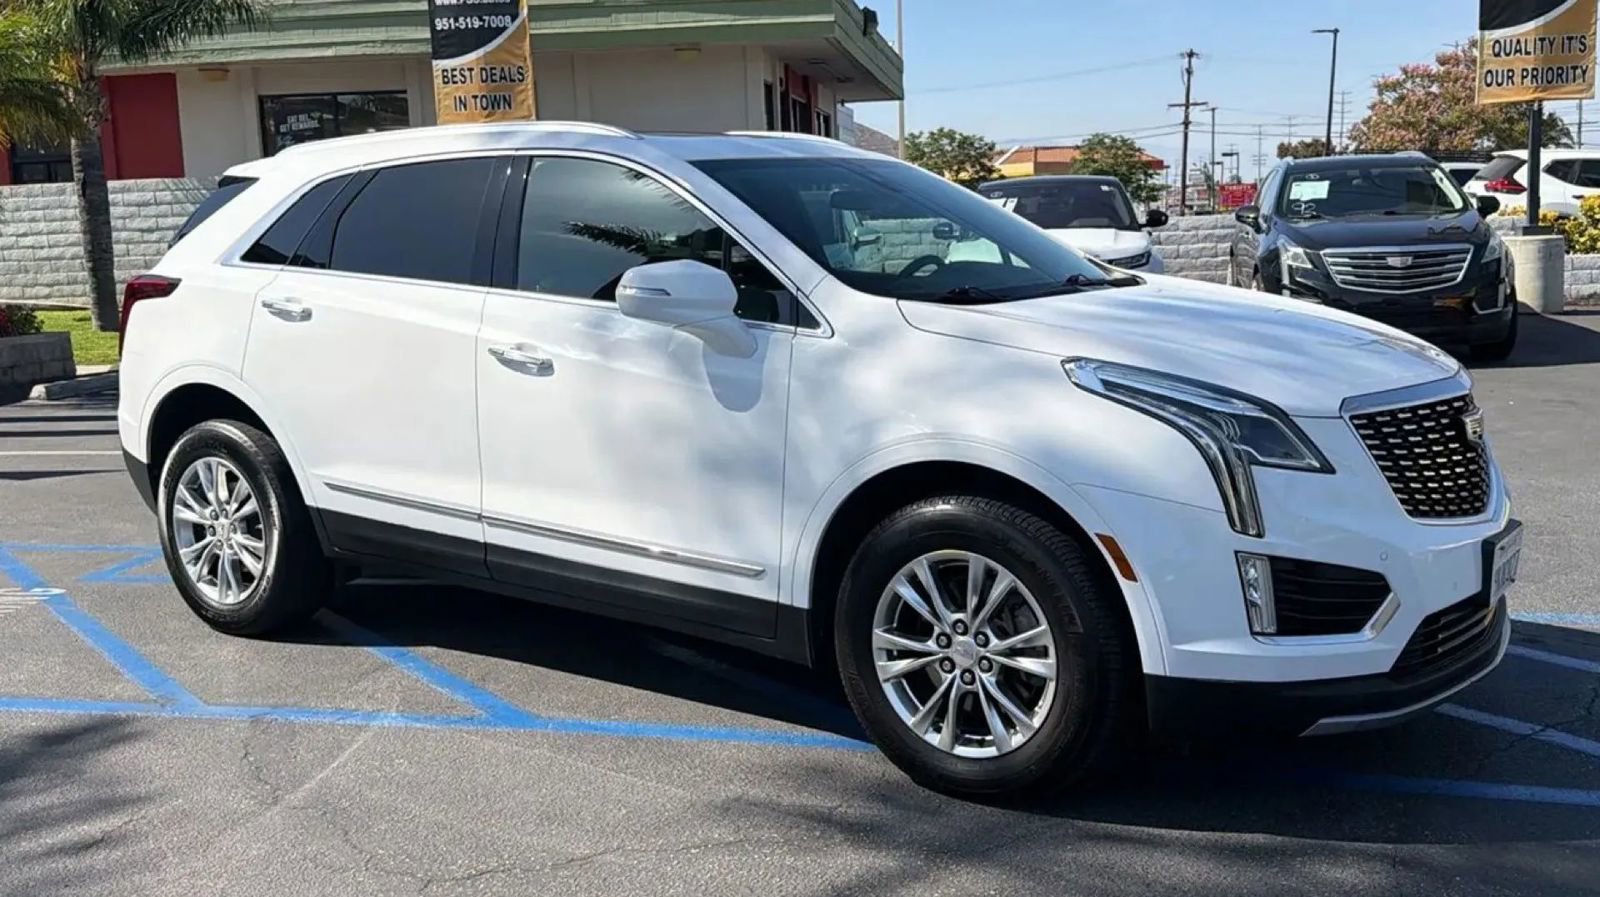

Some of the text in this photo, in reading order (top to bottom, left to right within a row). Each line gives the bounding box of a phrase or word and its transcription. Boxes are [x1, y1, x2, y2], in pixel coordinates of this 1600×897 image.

[434, 15, 512, 31] 951-519-7008
[1492, 35, 1588, 57] QUALITY IT'S
[441, 65, 525, 85] BEST DEALS
[1484, 65, 1589, 88] OUR PRIORITY
[454, 94, 512, 112] IN TOWN
